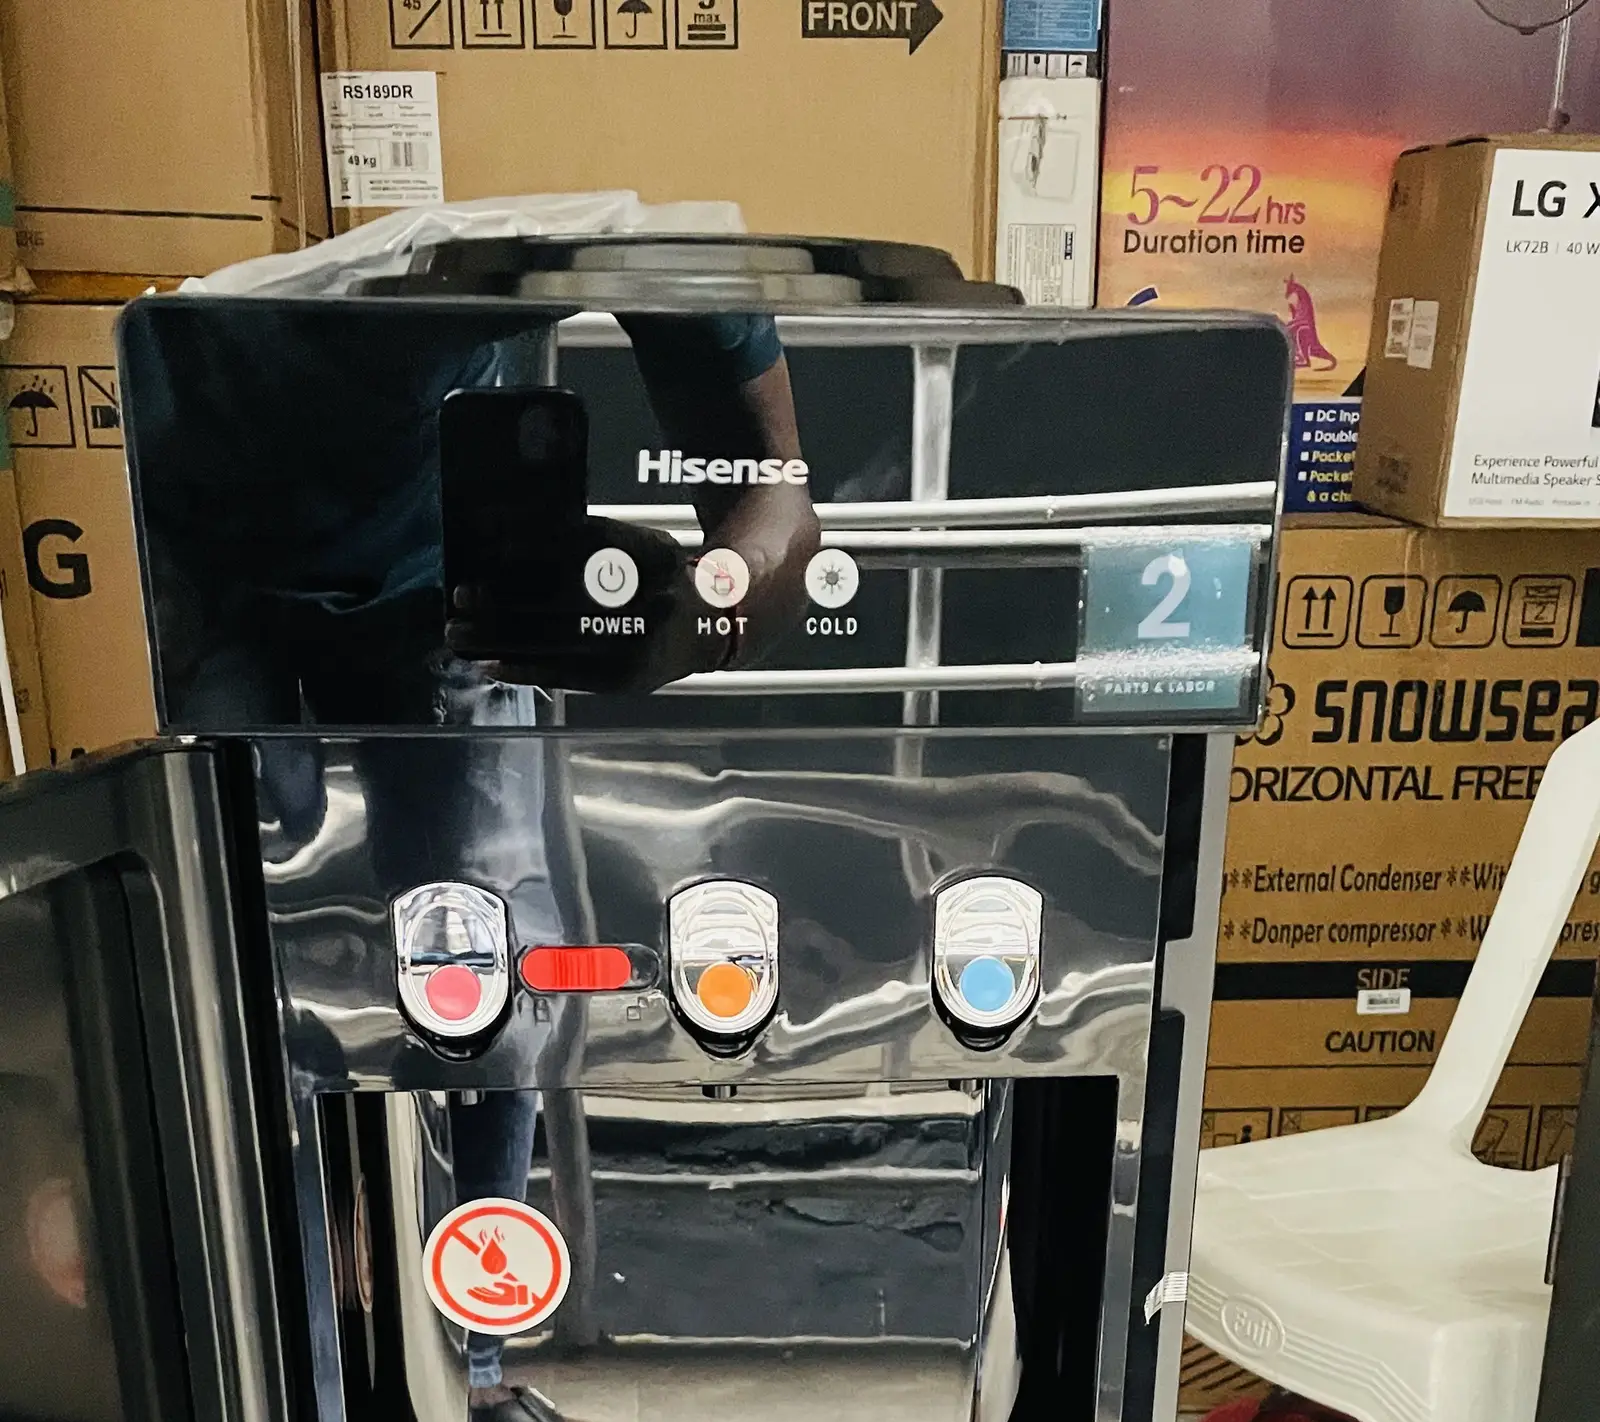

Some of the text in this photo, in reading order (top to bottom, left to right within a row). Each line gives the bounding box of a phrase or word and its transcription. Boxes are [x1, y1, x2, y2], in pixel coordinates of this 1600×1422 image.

[694, 12, 721, 23] max
[807, 2, 918, 31] FRONT
[343, 84, 414, 99] RS189DR
[1512, 179, 1567, 218] LG
[1123, 229, 1305, 254] Duration time
[1506, 240, 1549, 254] LK72B
[1566, 241, 1583, 255] 40
[1316, 409, 1360, 424] DC Inp
[638, 449, 809, 485] Hisense
[1474, 454, 1599, 470] Experience Powerful
[1471, 472, 1540, 485] Multimedia
[1543, 473, 1593, 489] Speaker
[1137, 554, 1191, 639] 2
[580, 617, 645, 635] POWER
[698, 617, 748, 635] HOT
[806, 617, 858, 635] COLD
[1168, 680, 1216, 693] LABOR
[1229, 765, 1550, 802] ORIZONTAL FREE
[1340, 864, 1440, 892] Condenser
[1328, 920, 1436, 949] compressor
[1325, 1029, 1436, 1053] CAUTION
